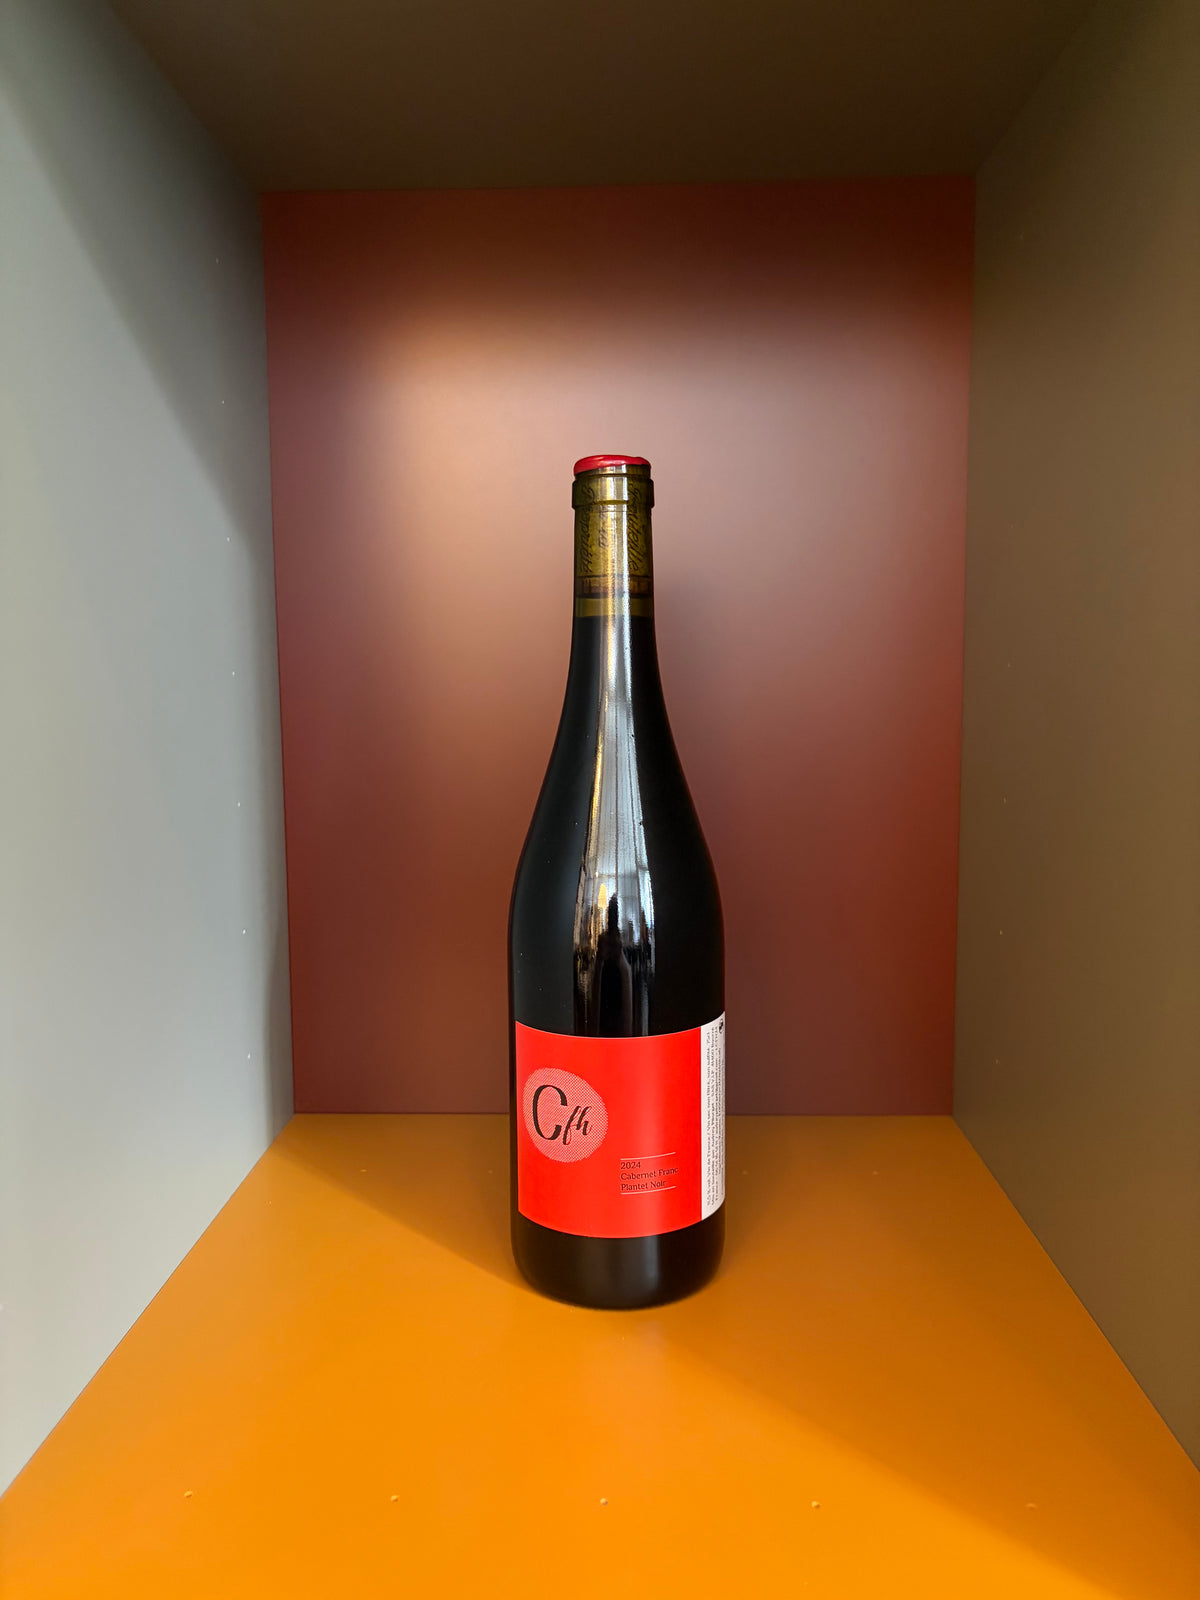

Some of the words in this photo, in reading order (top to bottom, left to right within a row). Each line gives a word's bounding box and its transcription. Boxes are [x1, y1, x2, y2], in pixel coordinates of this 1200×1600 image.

[620, 1161, 641, 1170] 2024
[620, 1172, 657, 1181] Cabernet
[658, 1167, 679, 1176] Franc
[620, 1182, 649, 1192] Plantet
[650, 1179, 666, 1189] Noir
